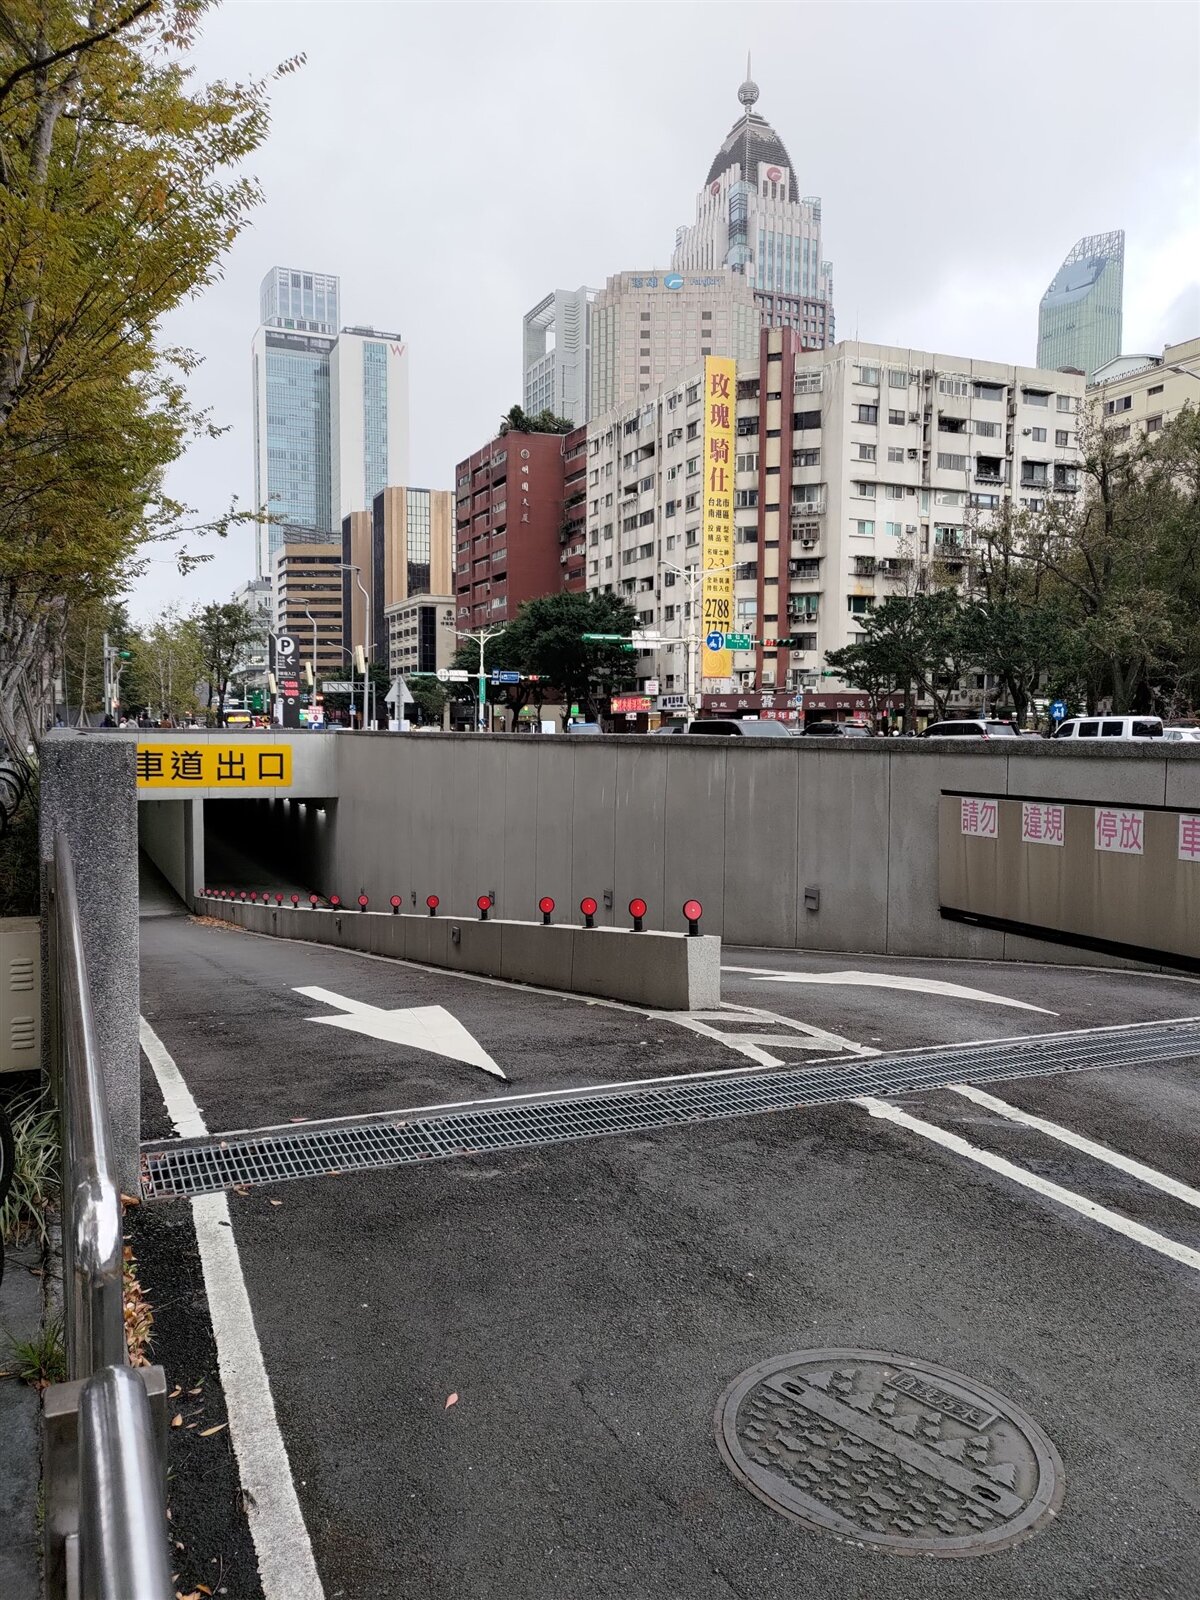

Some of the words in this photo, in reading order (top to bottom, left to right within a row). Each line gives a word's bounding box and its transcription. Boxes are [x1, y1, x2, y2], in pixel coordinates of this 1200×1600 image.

[390, 343, 405, 357] W
[710, 373, 730, 493] 玫瑰騎仕
[708, 497, 729, 507] 台北市
[708, 509, 729, 519] 南港區
[705, 599, 729, 618] 2788
[281, 640, 290, 652] P
[137, 750, 284, 781] 車道出口
[962, 800, 996, 833] 請勿
[1023, 805, 1063, 842] 違規
[1097, 811, 1142, 850] 停放
[1181, 818, 1200, 857] 車
